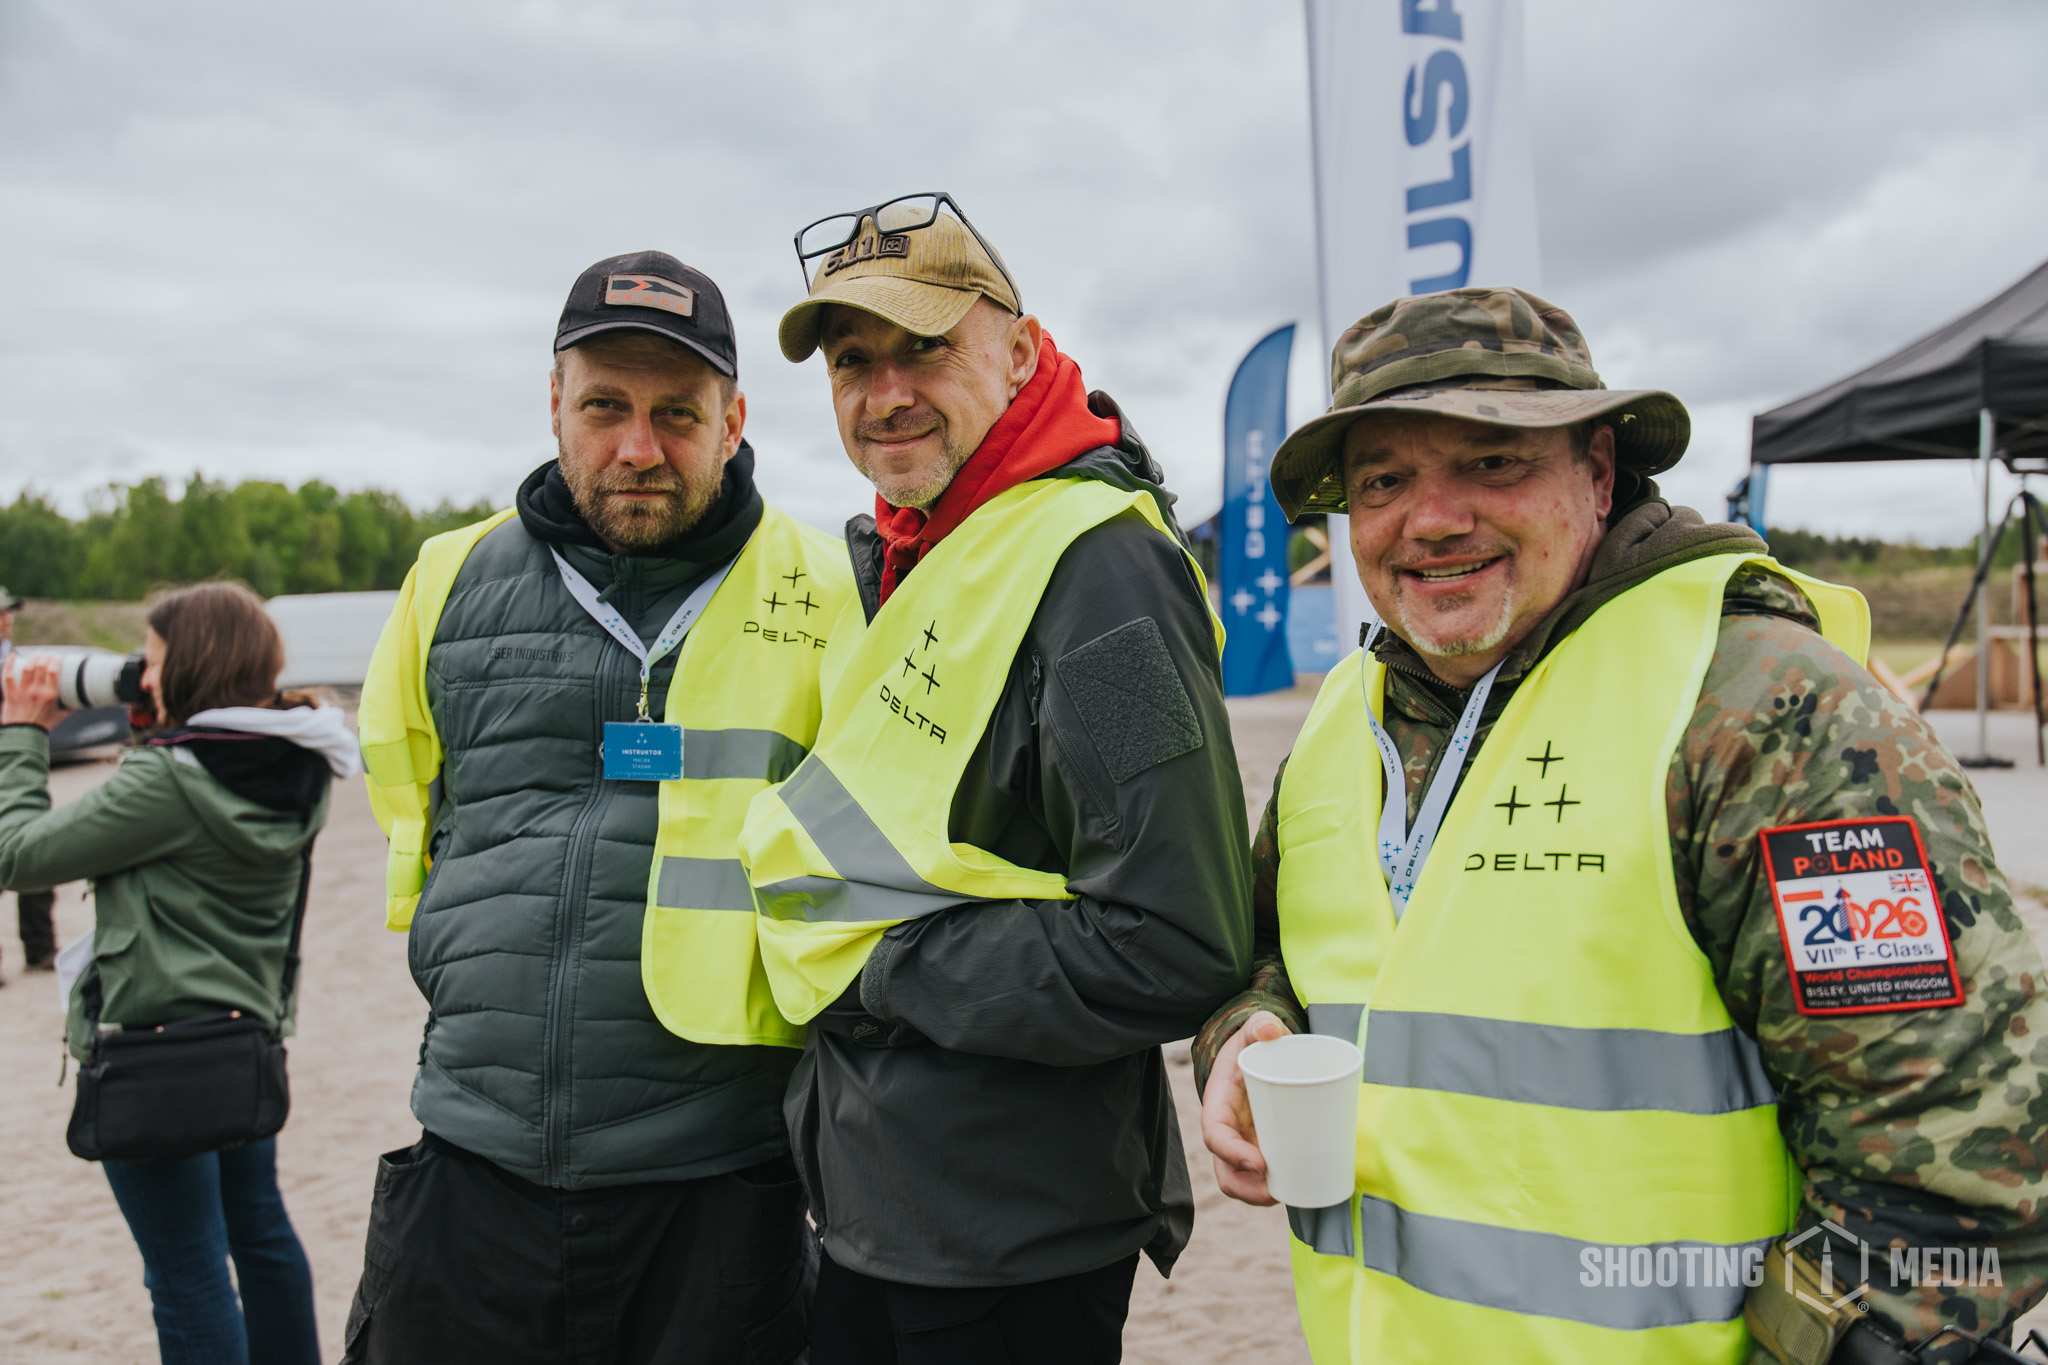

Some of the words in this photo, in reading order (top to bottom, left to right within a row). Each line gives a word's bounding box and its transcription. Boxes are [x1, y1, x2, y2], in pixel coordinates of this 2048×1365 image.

[824, 235, 875, 278] 5.11
[609, 294, 685, 312] PEACE
[671, 609, 692, 636] DELTA
[515, 647, 575, 663] INDUSTRIES
[879, 684, 947, 745] DELTA
[1465, 686, 1484, 729] DELTA
[1380, 737, 1396, 774] DELTA
[1805, 828, 1885, 853] TEAM
[1405, 834, 1424, 877] DELTA
[1464, 853, 1605, 872] DELTA
[1793, 848, 1904, 877] POLAND
[1799, 896, 1928, 946] 2026
[1855, 942, 1934, 960] F-Class
[1803, 970, 1844, 983] World
[1846, 963, 1945, 981] Championships
[1848, 981, 1892, 995] UNITED
[1893, 977, 1949, 991] KINGDOM
